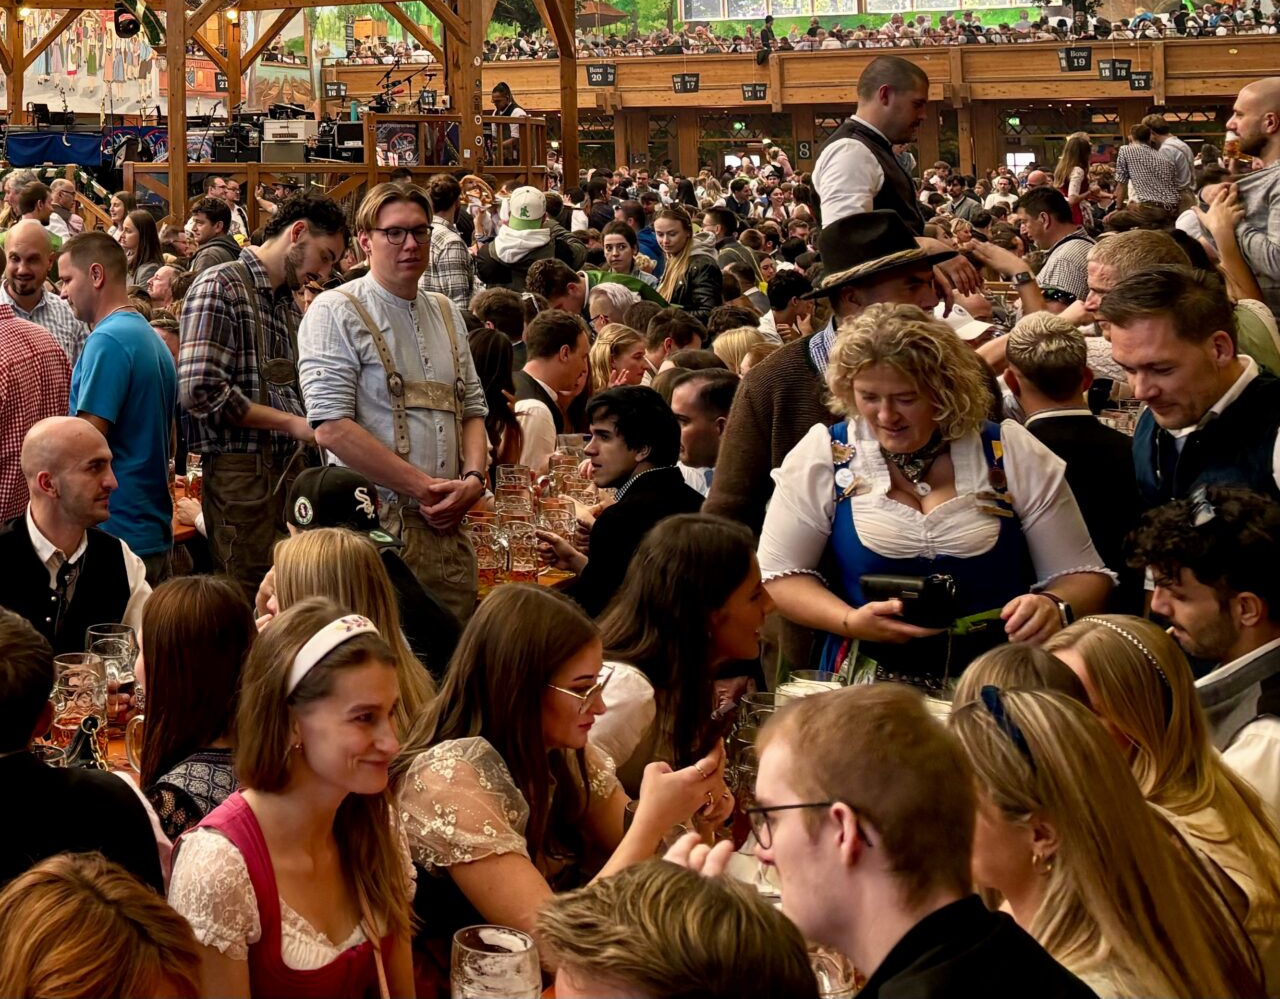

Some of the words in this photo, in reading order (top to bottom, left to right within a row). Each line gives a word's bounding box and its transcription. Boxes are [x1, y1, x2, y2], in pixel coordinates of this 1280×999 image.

[1073, 58, 1086, 67] 19
[591, 73, 602, 82] 20
[1116, 69, 1127, 77] 18
[1134, 80, 1145, 88] 13
[799, 142, 810, 158] 8
[353, 486, 376, 520] Sox
